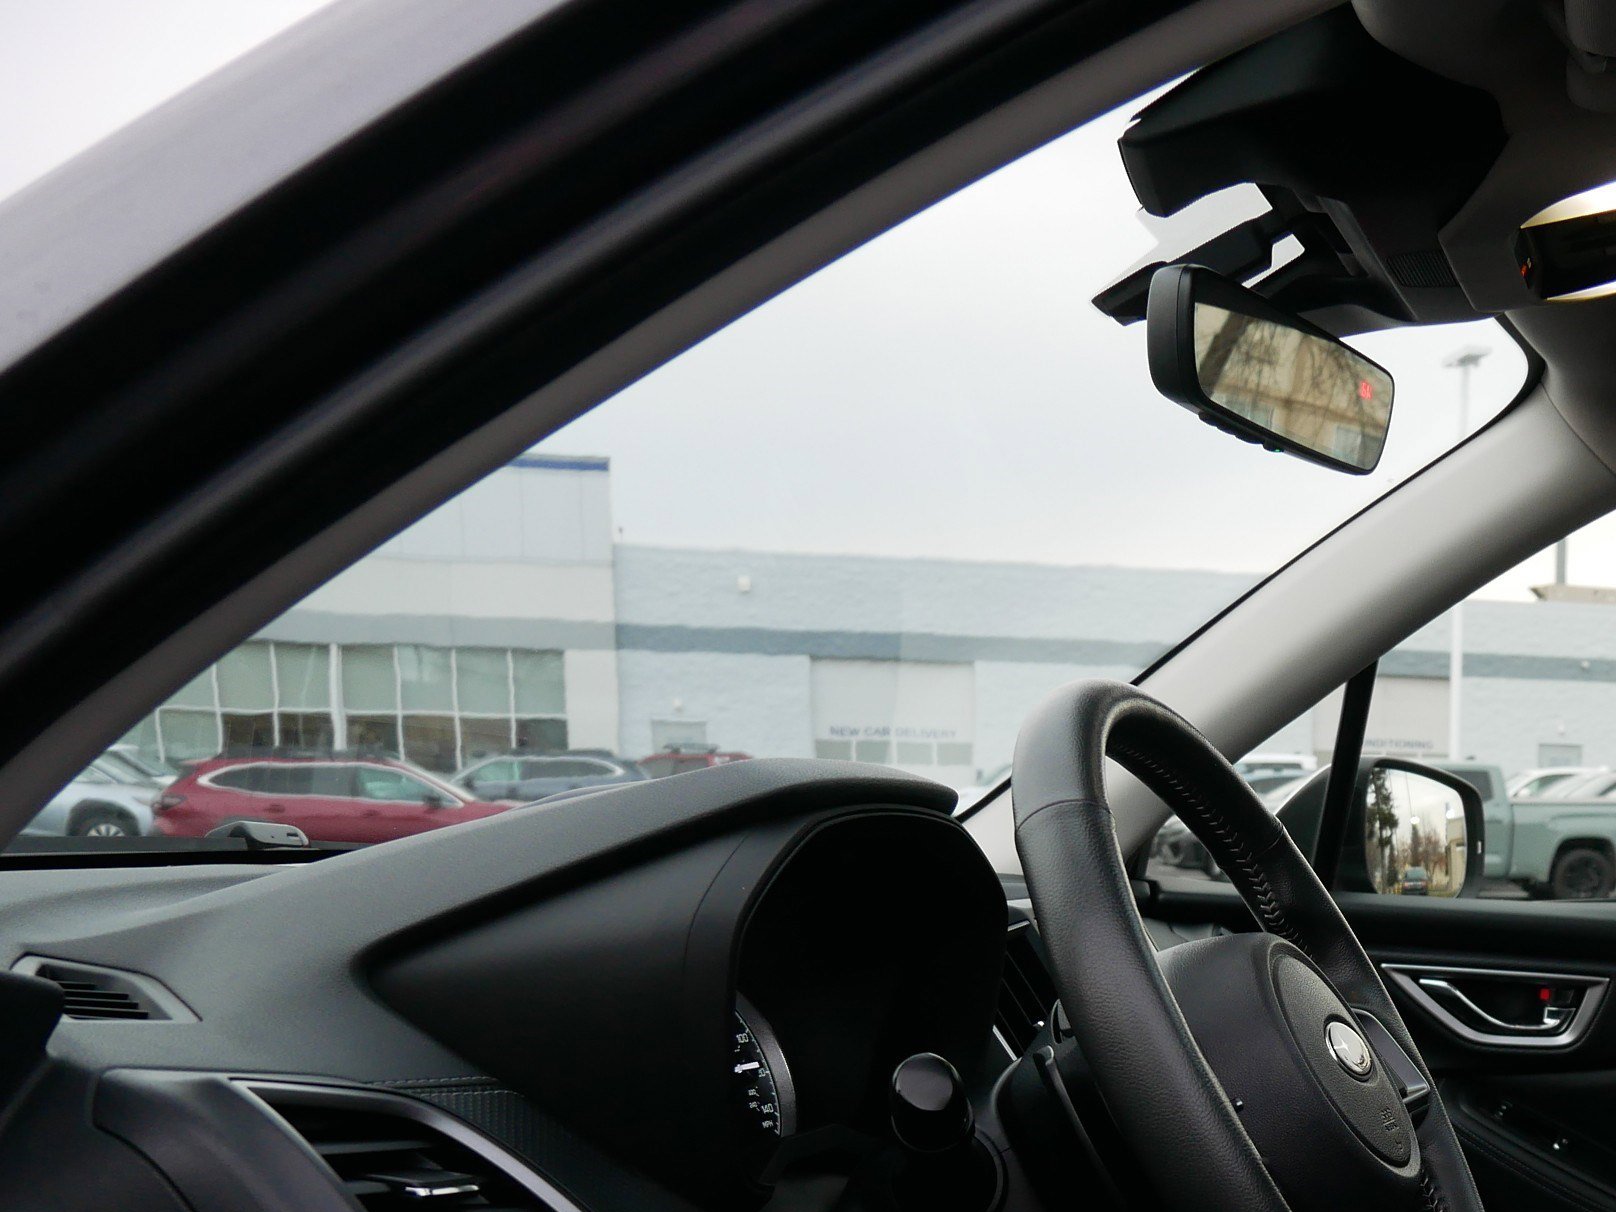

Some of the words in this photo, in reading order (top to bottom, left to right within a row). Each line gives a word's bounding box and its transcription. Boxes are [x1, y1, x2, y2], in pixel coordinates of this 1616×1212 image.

[829, 726, 859, 737] NEW
[863, 726, 891, 737] CAR
[895, 726, 957, 738] DELIVERY
[1364, 738, 1434, 750] NDITIONING
